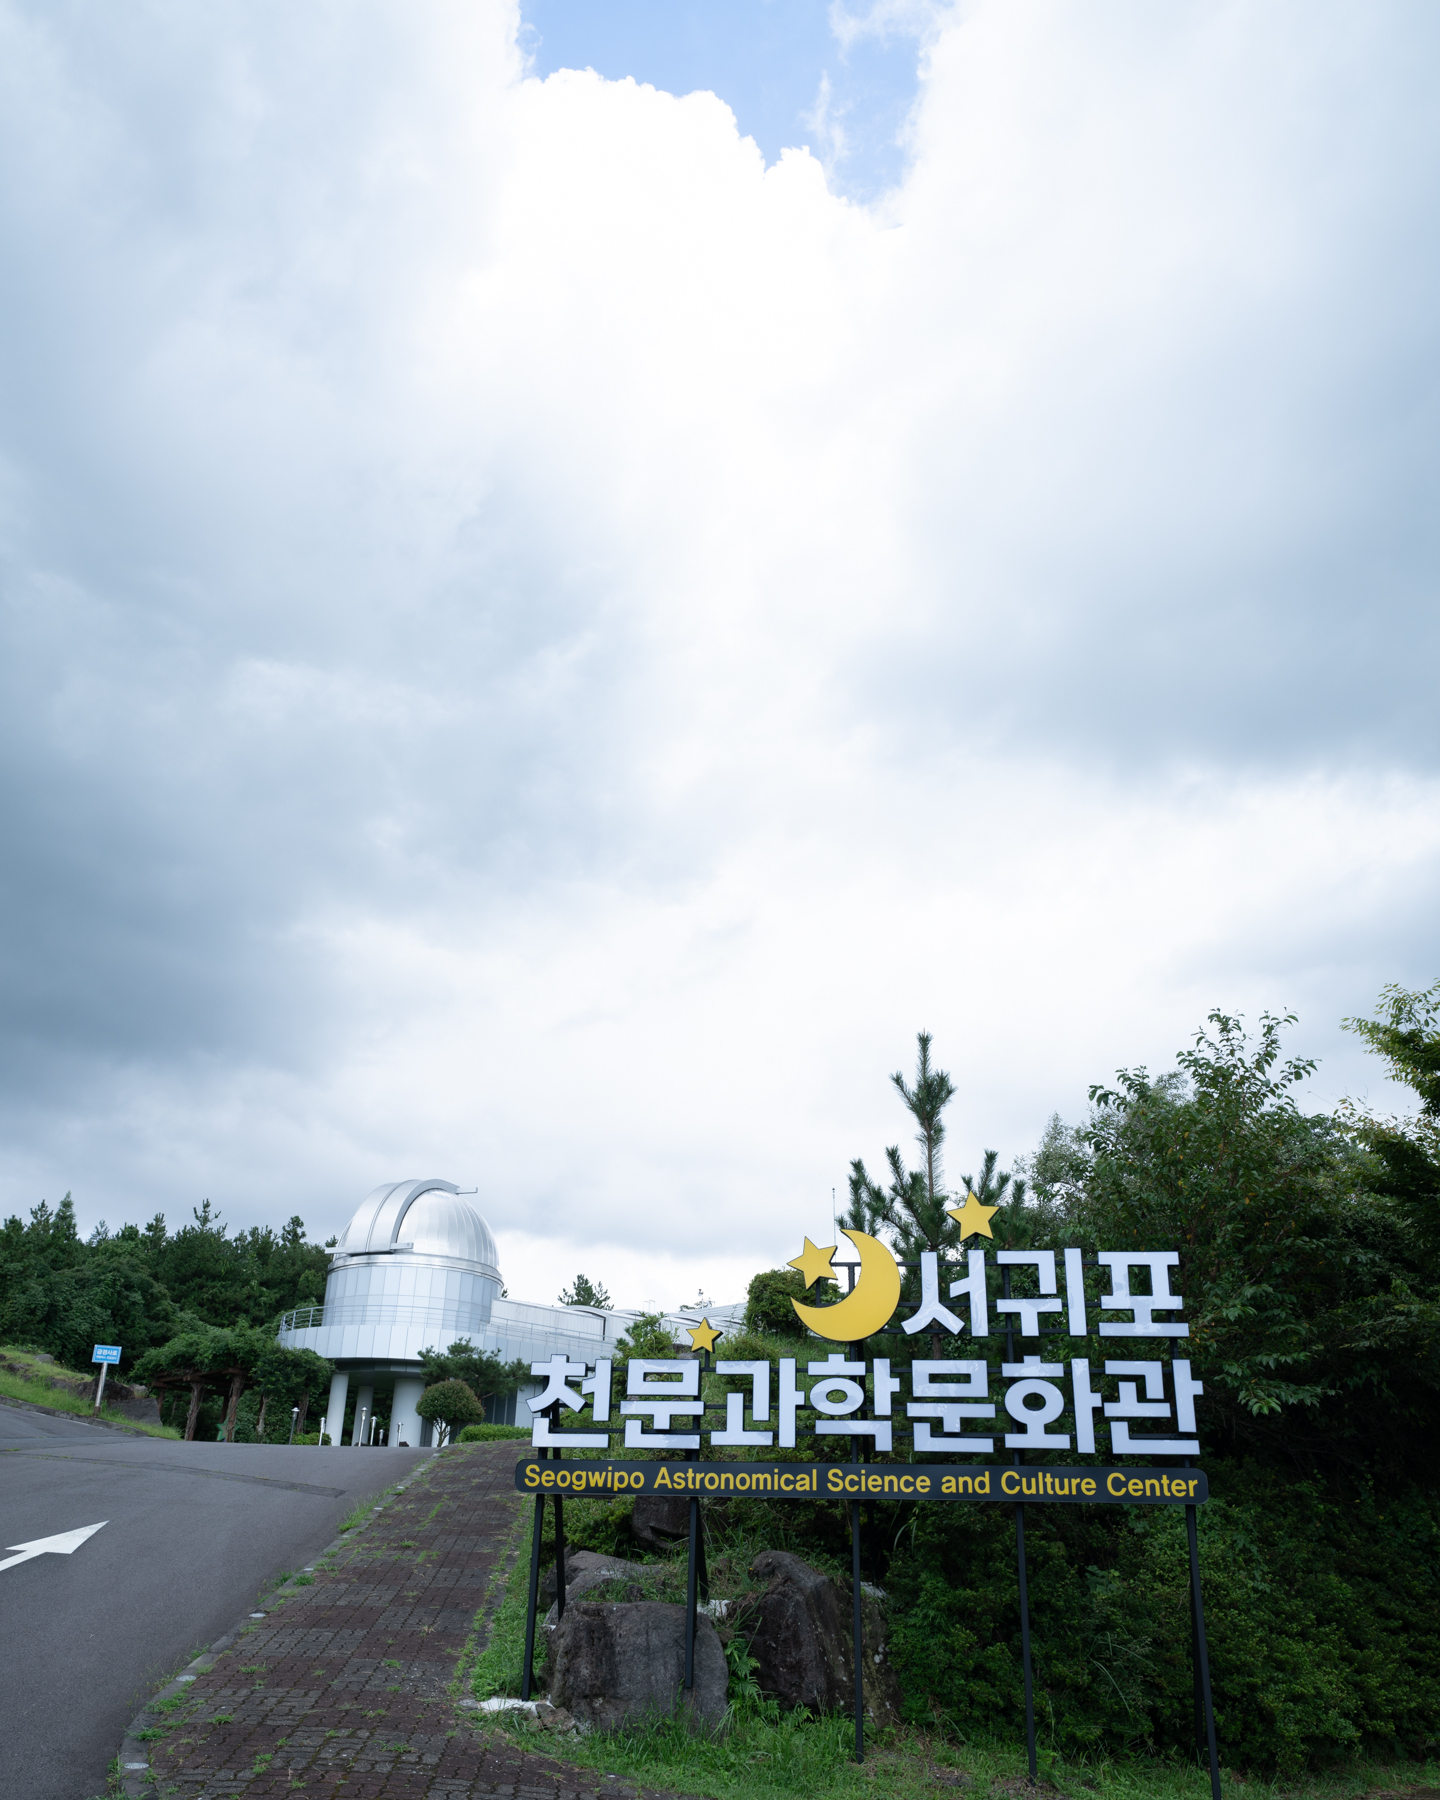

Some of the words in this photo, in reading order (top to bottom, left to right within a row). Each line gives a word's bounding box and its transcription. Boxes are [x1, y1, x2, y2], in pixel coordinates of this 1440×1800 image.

[901, 1248, 1190, 1337] 서귀포
[526, 1353, 1204, 1455] 천문과학문화관
[524, 1464, 645, 1492] Seogwipo
[653, 1466, 818, 1492] Astronomical
[826, 1468, 931, 1494] Science
[941, 1470, 991, 1495] and
[1000, 1470, 1097, 1496] Culture
[1106, 1472, 1199, 1498] Center
